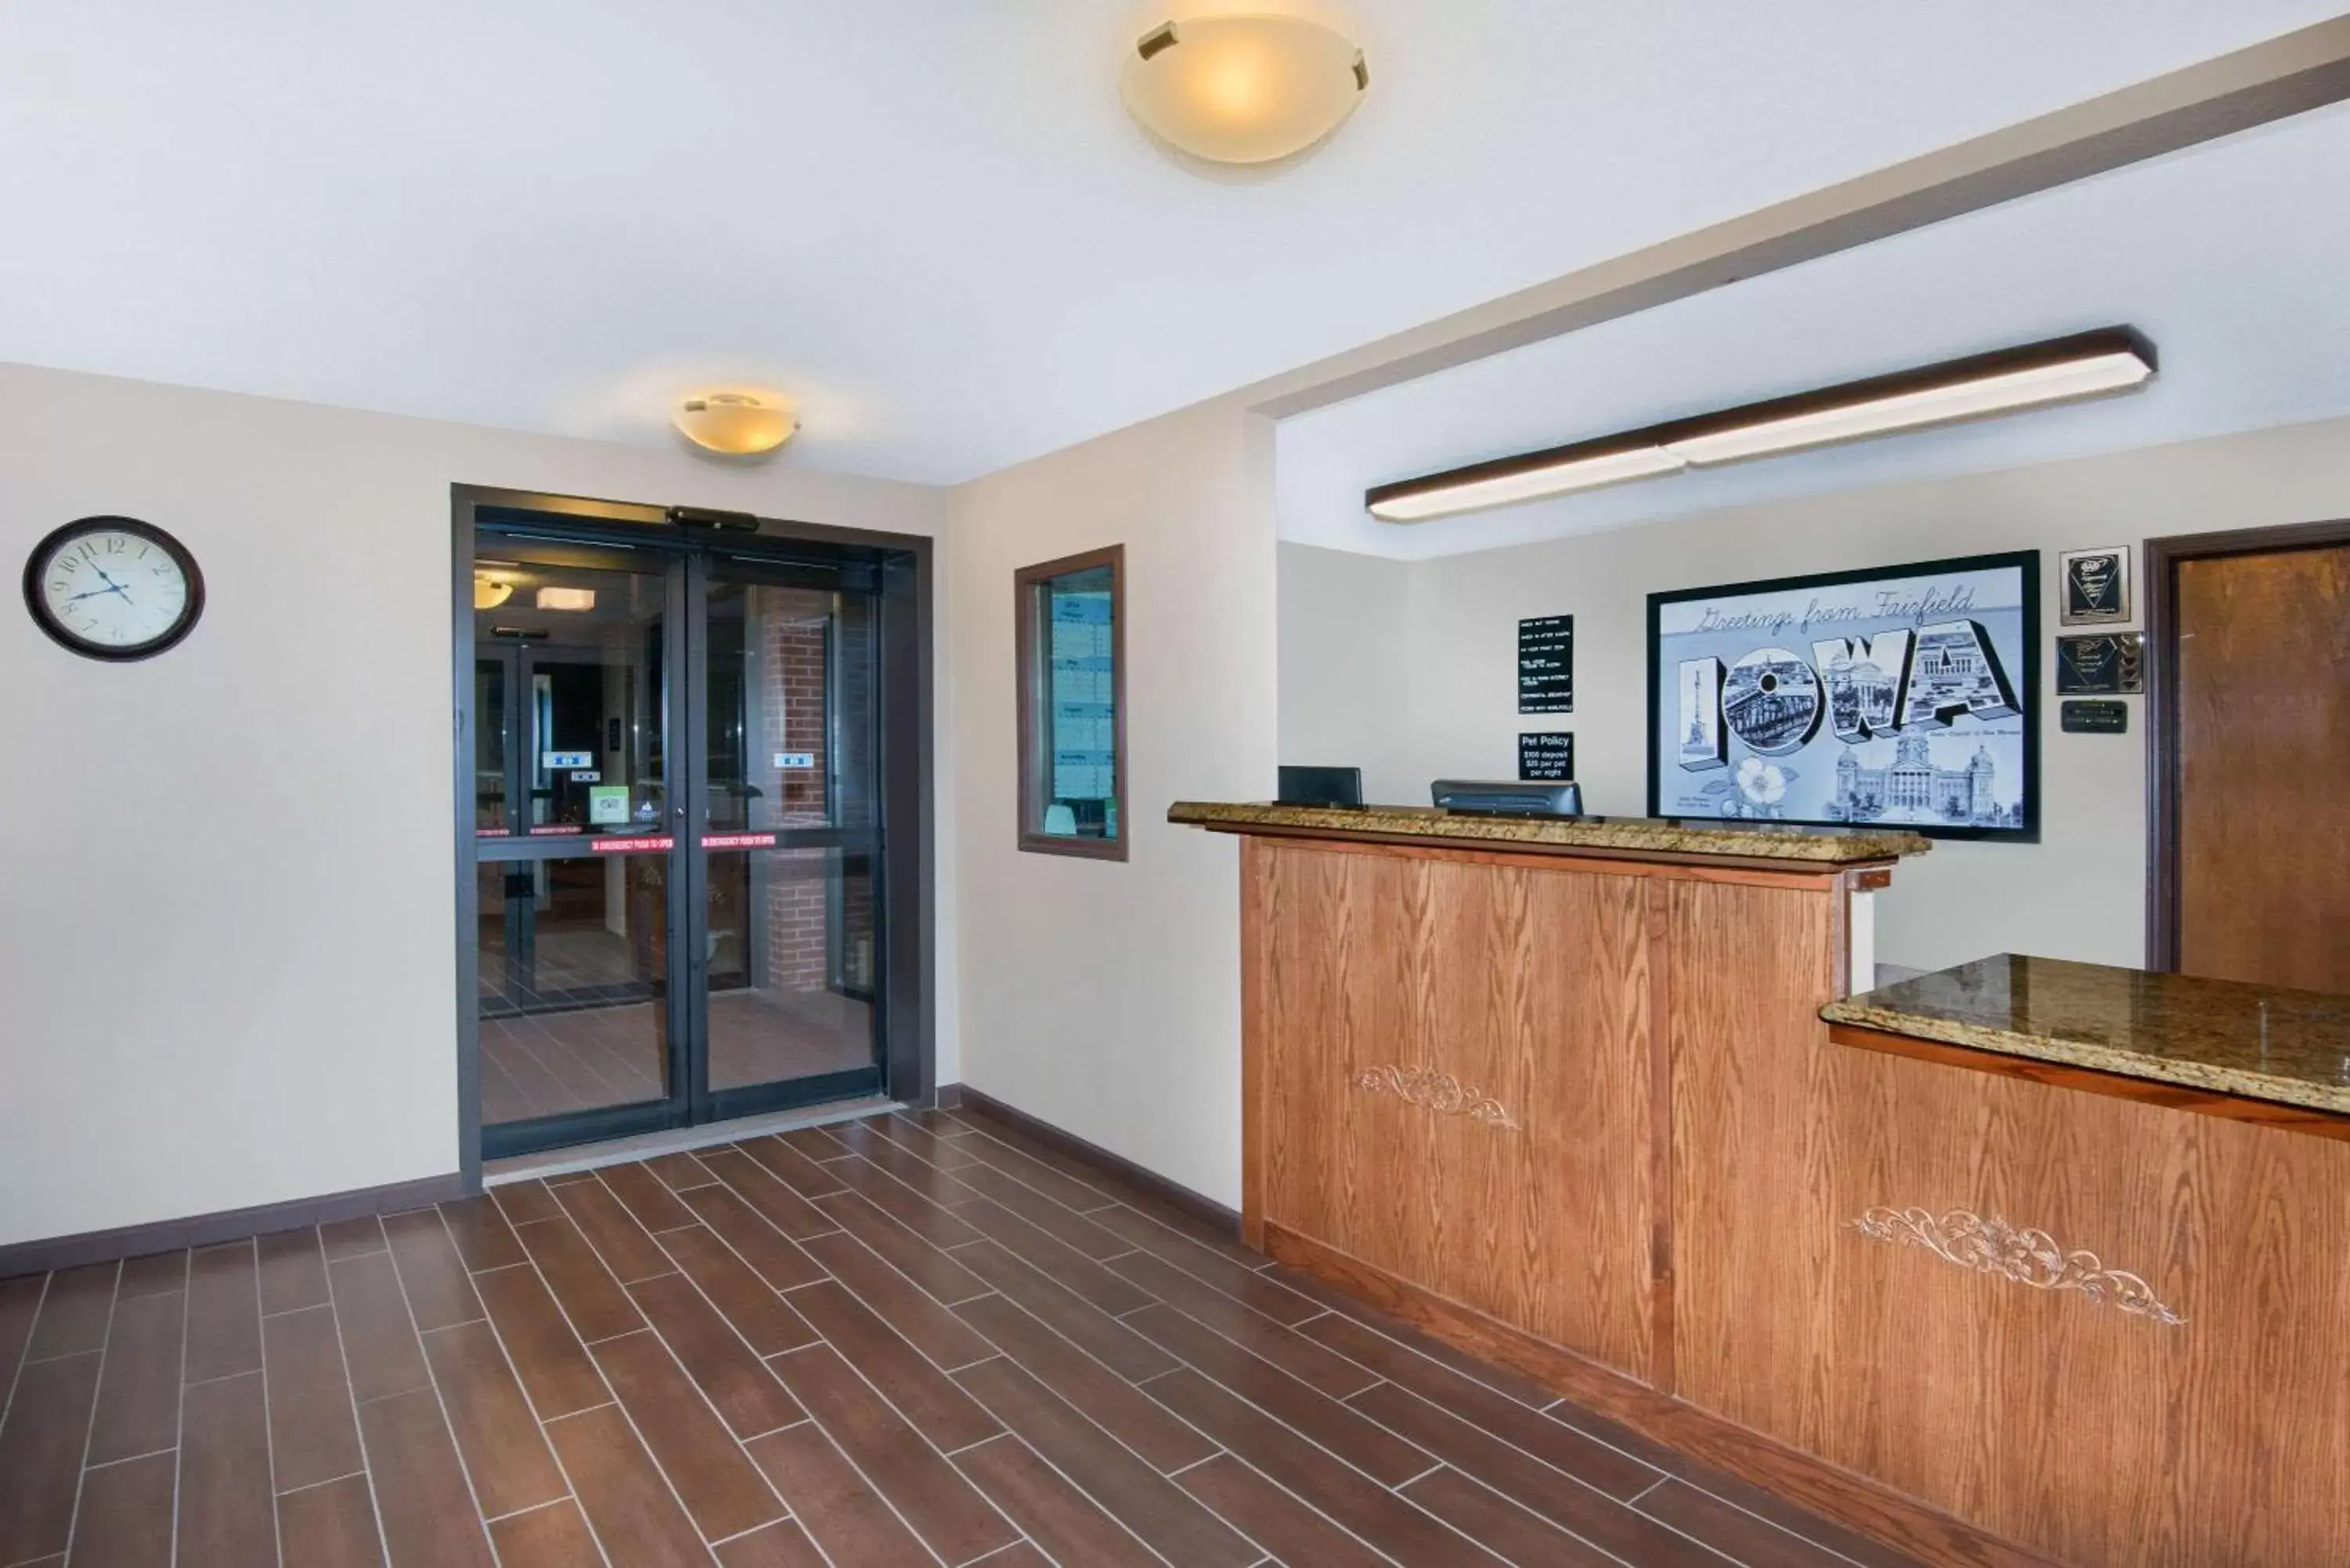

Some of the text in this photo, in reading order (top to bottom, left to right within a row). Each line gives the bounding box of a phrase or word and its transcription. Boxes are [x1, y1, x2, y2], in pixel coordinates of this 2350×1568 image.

[107, 537, 125, 554] 12
[137, 547, 149, 561] 1
[58, 555, 80, 574] 10
[151, 562, 171, 576] 2
[52, 581, 69, 592] 9
[61, 602, 79, 616] 8
[1697, 585, 1976, 637] Greetings from Fairfield
[82, 618, 99, 632] 7
[1679, 618, 2023, 771] IOWA
[1522, 735, 1570, 748] Pet Policy
